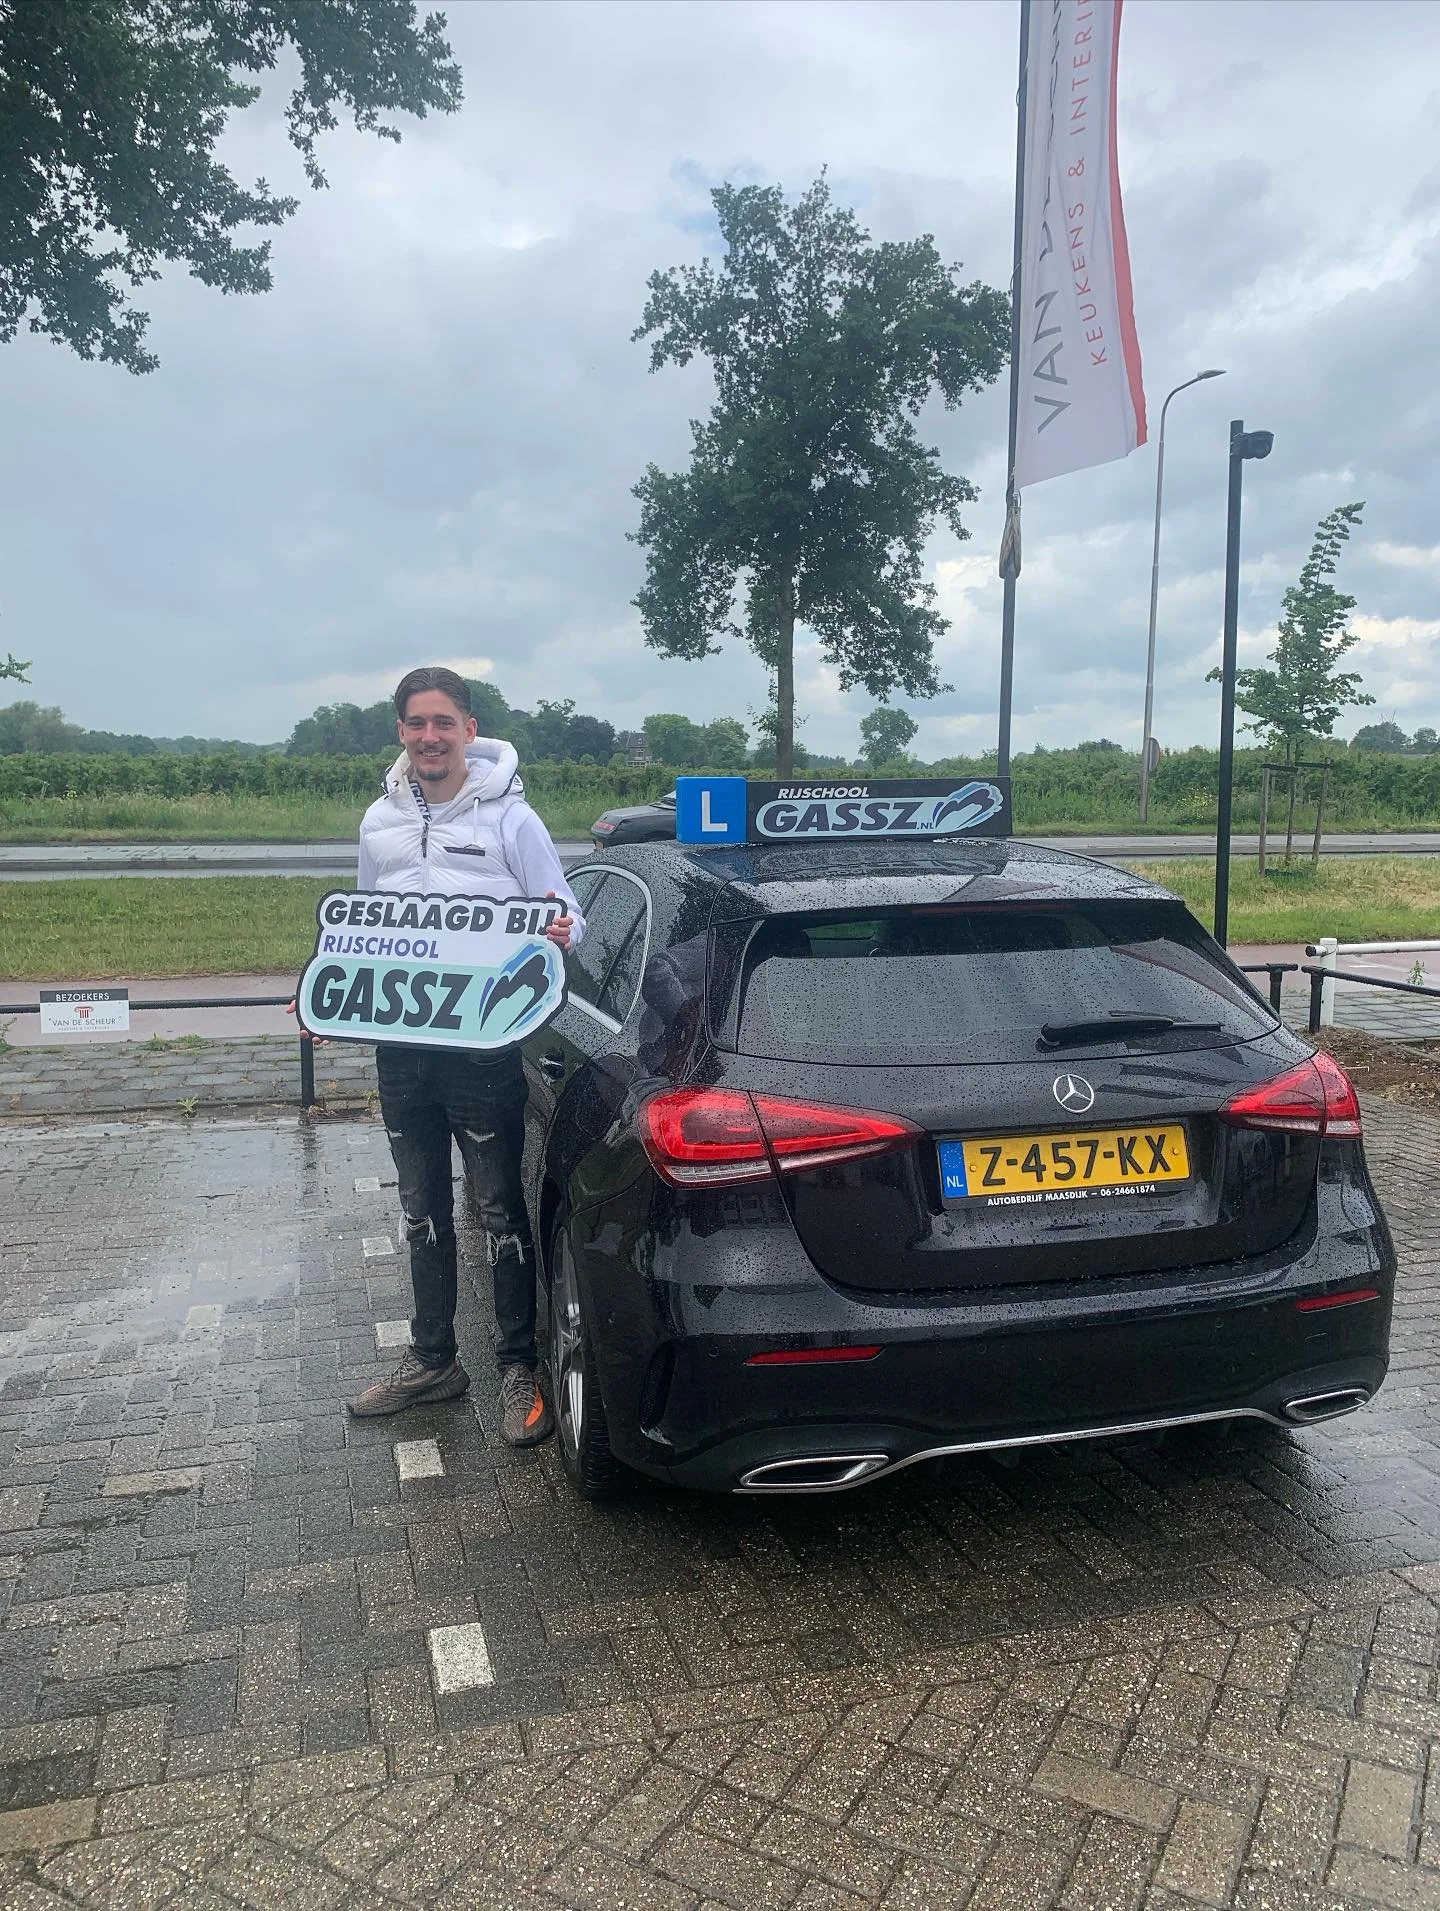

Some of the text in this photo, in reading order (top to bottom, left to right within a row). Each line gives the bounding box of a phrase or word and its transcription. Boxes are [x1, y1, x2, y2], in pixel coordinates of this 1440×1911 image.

[1068, 157, 1085, 177] &
[1068, 203, 1108, 366] KEUKENS
[1033, 290, 1072, 434] VAN
[777, 786, 870, 799] RIJSCHOOL
[701, 791, 728, 832] L
[324, 899, 556, 935] GESLAAGD BIJ
[323, 934, 439, 959] RIJSCHOOL
[55, 992, 110, 1002] BEZOEKERS
[311, 965, 473, 1030] GASSZ
[85, 1017, 116, 1026] SCHEUR
[980, 1133, 1171, 1187] Z-457-KX
[946, 1175, 964, 1189] NL
[987, 1192, 1043, 1207] AUTOBEDRIJF
[1045, 1190, 1088, 1202] MAASDIJK
[1100, 1184, 1156, 1197] 06-24661874
